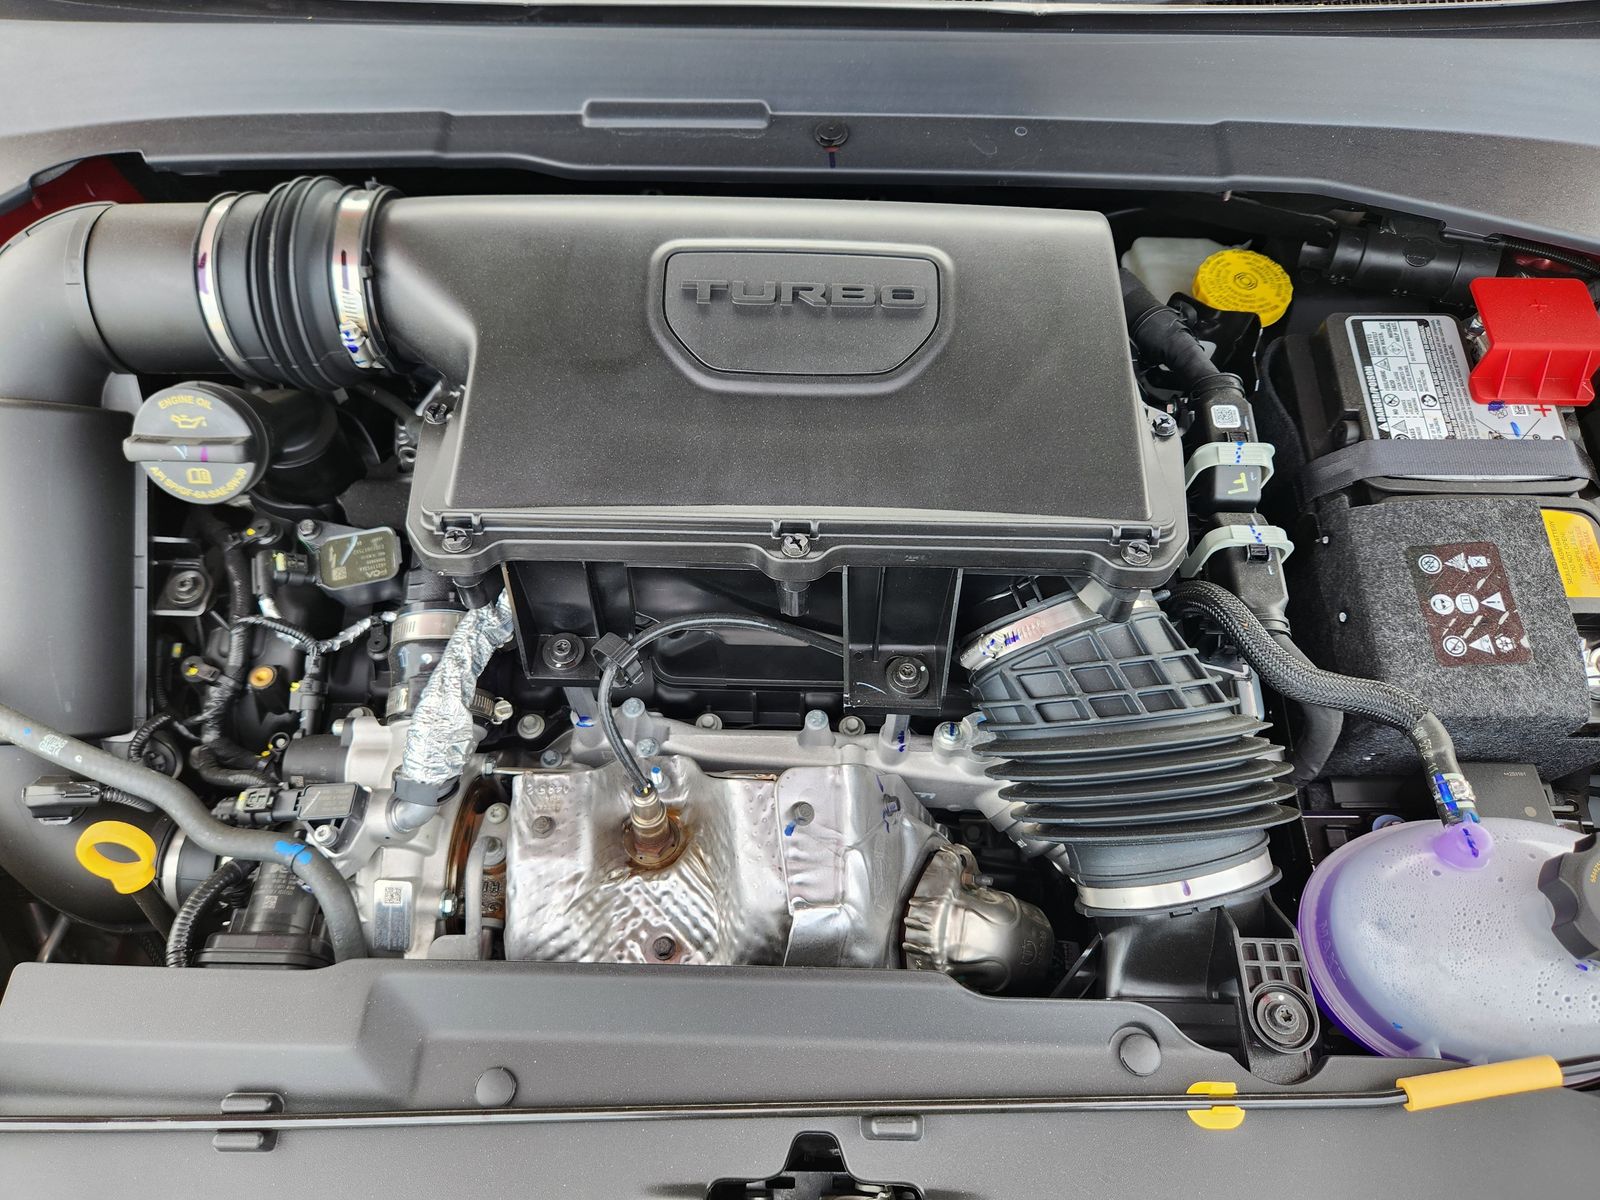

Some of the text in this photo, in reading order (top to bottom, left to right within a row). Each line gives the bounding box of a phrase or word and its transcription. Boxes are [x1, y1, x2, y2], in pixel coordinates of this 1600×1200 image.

[680, 279, 926, 308] TURBO
[1384, 322, 1393, 337] MEDICAL
[159, 395, 213, 410] ENGINE OIL
[1363, 365, 1386, 421] DANGER/POISON
